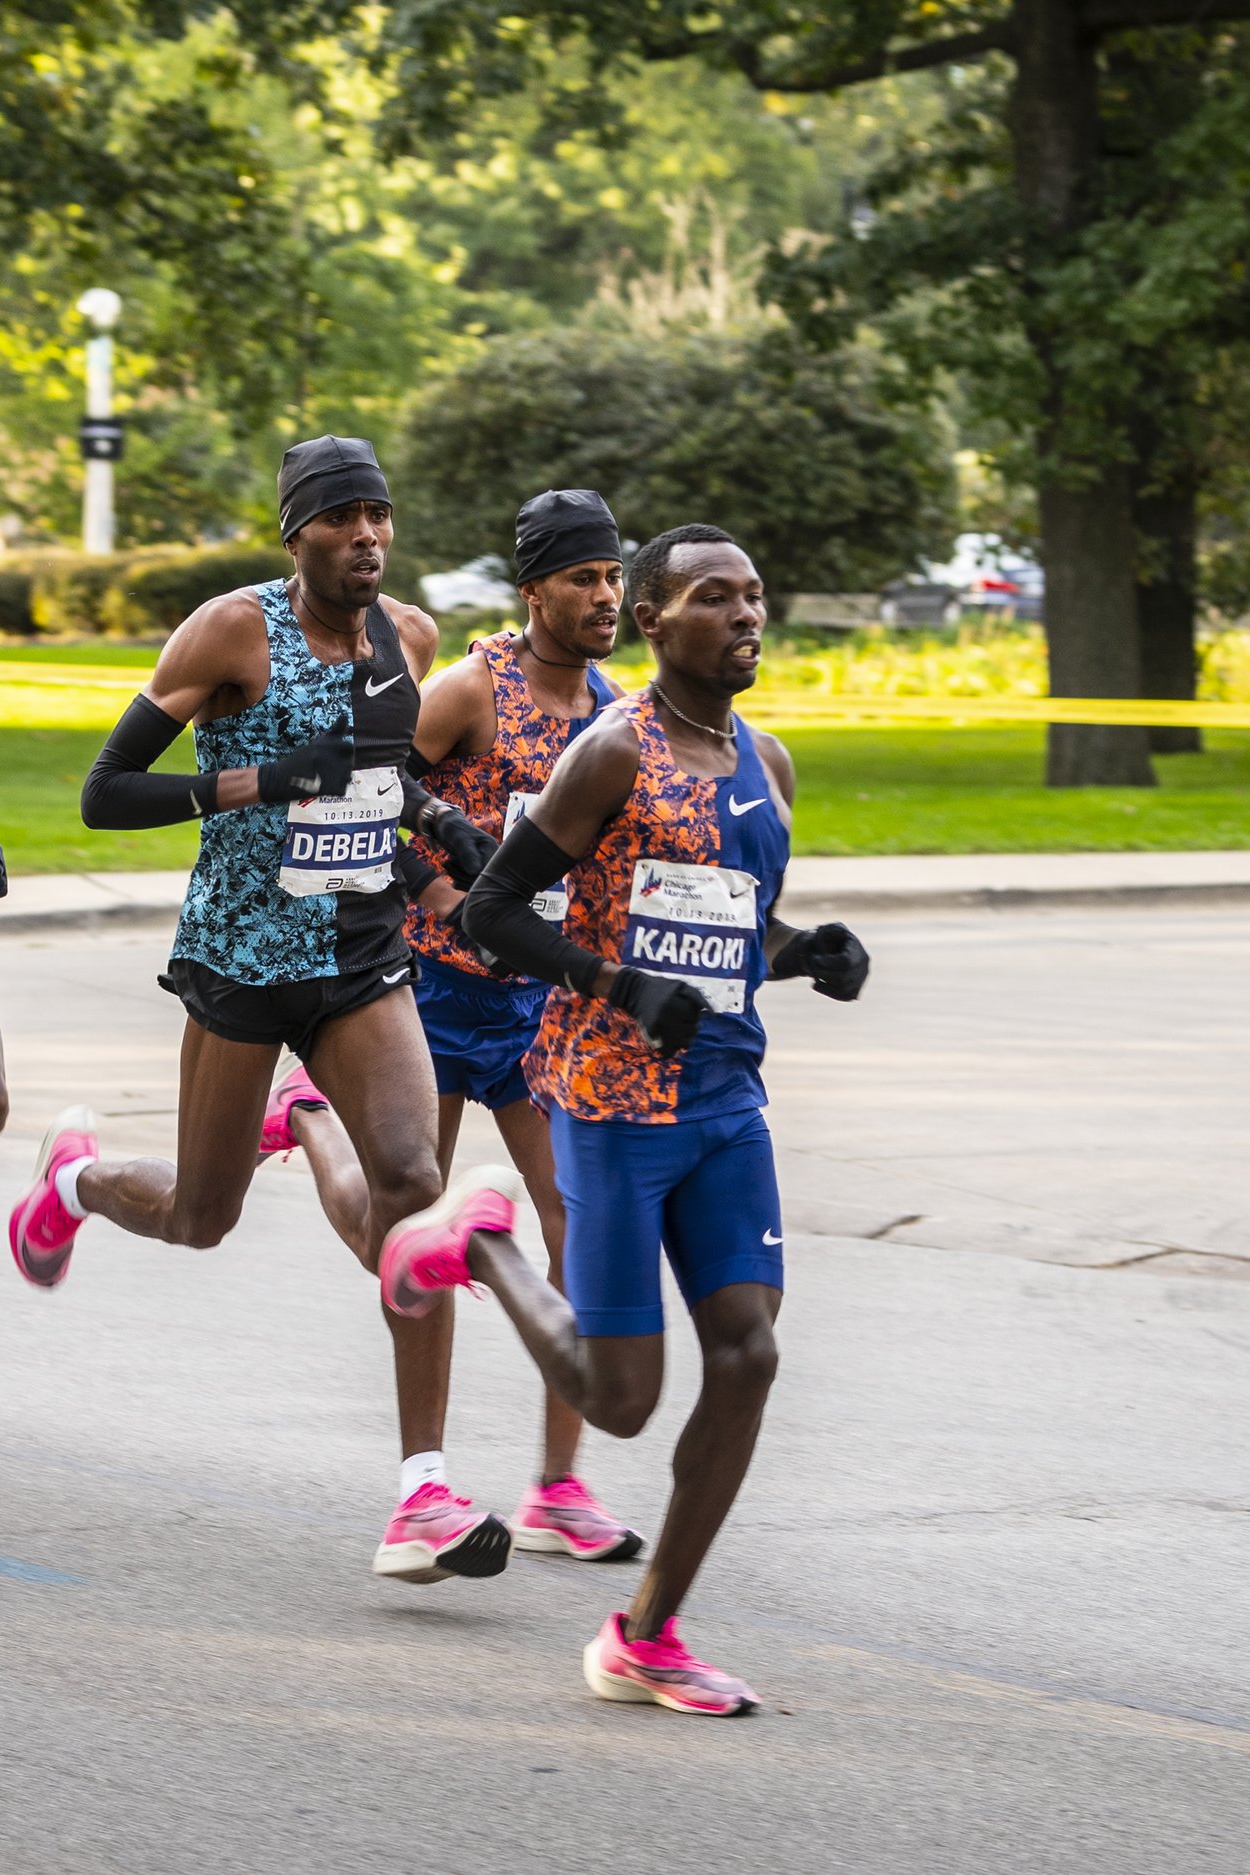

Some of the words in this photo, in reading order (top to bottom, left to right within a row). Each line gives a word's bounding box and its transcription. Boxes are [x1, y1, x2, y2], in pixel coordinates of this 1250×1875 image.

[319, 795, 353, 804] Marathon
[324, 809, 384, 820] 10.13.2019
[292, 827, 392, 862] DEBELA
[632, 925, 745, 970] KAROKI
